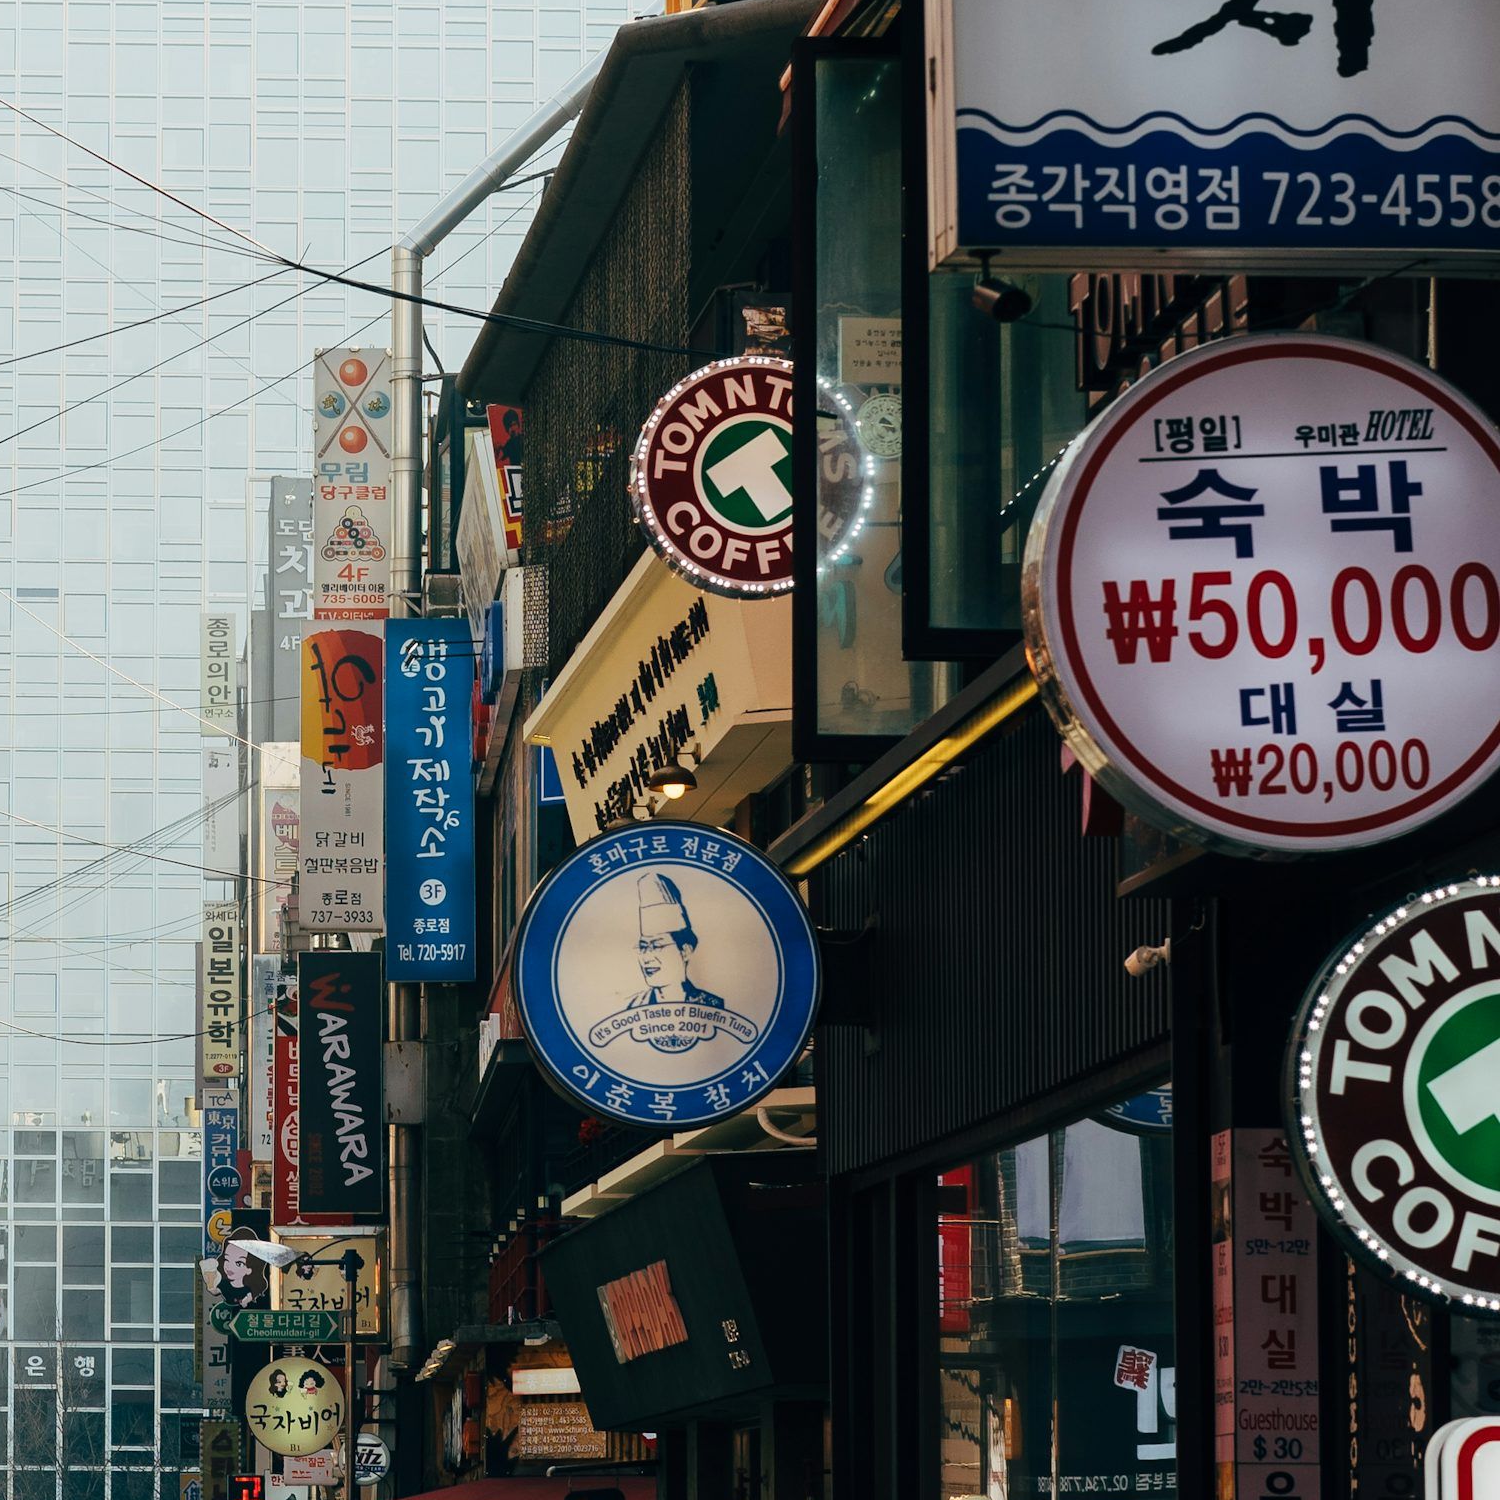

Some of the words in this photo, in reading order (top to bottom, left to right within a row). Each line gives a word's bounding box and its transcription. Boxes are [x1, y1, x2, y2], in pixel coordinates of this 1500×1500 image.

[987, 162, 1243, 231] 종각직영점
[1294, 422, 1360, 449] 우미관
[1362, 407, 1435, 443] HOTEL
[319, 461, 369, 484] 무림
[320, 485, 387, 501] 당구클럽
[1156, 460, 1424, 559] 숙박
[336, 562, 370, 582] 4F
[321, 594, 385, 604] 735-6005
[279, 635, 300, 650] 4F
[1240, 680, 1386, 736] 대실
[1211, 738, 1431, 804] ₩20,000
[315, 831, 365, 848] 닭갈비
[588, 834, 672, 874] 혼마구로
[680, 833, 743, 873] 전문점
[304, 856, 379, 875] 철판볶음밥
[320, 889, 363, 907] 종로점
[420, 882, 443, 901] 3F
[204, 909, 238, 922] 와세다
[310, 909, 374, 924] 737-3933
[412, 917, 451, 935] 종로점
[396, 944, 415, 963] Tel.
[417, 943, 467, 964] 720-5917
[206, 926, 235, 1050] 일본유학
[610, 1014, 641, 1034] Good
[641, 1007, 672, 1020] Taste
[673, 1006, 686, 1018] of
[687, 1007, 727, 1026] Bluefin
[726, 1020, 752, 1039] Tuna
[639, 1022, 675, 1035] Since
[676, 1021, 707, 1034] 2001
[217, 1063, 230, 1073] 3F
[308, 972, 374, 1187] WARAWARA
[571, 1062, 680, 1122] 이춘복
[704, 1057, 771, 1117] 참치
[212, 1176, 240, 1188] 스위트
[246, 1312, 321, 1328] 철물다리길
[1261, 1273, 1298, 1371] 대실
[246, 1328, 320, 1339] Cheolmuldari-gil
[250, 1403, 341, 1436] 국자비어
[1239, 1407, 1319, 1433] Guesthouse
[1273, 1436, 1304, 1460] 30
